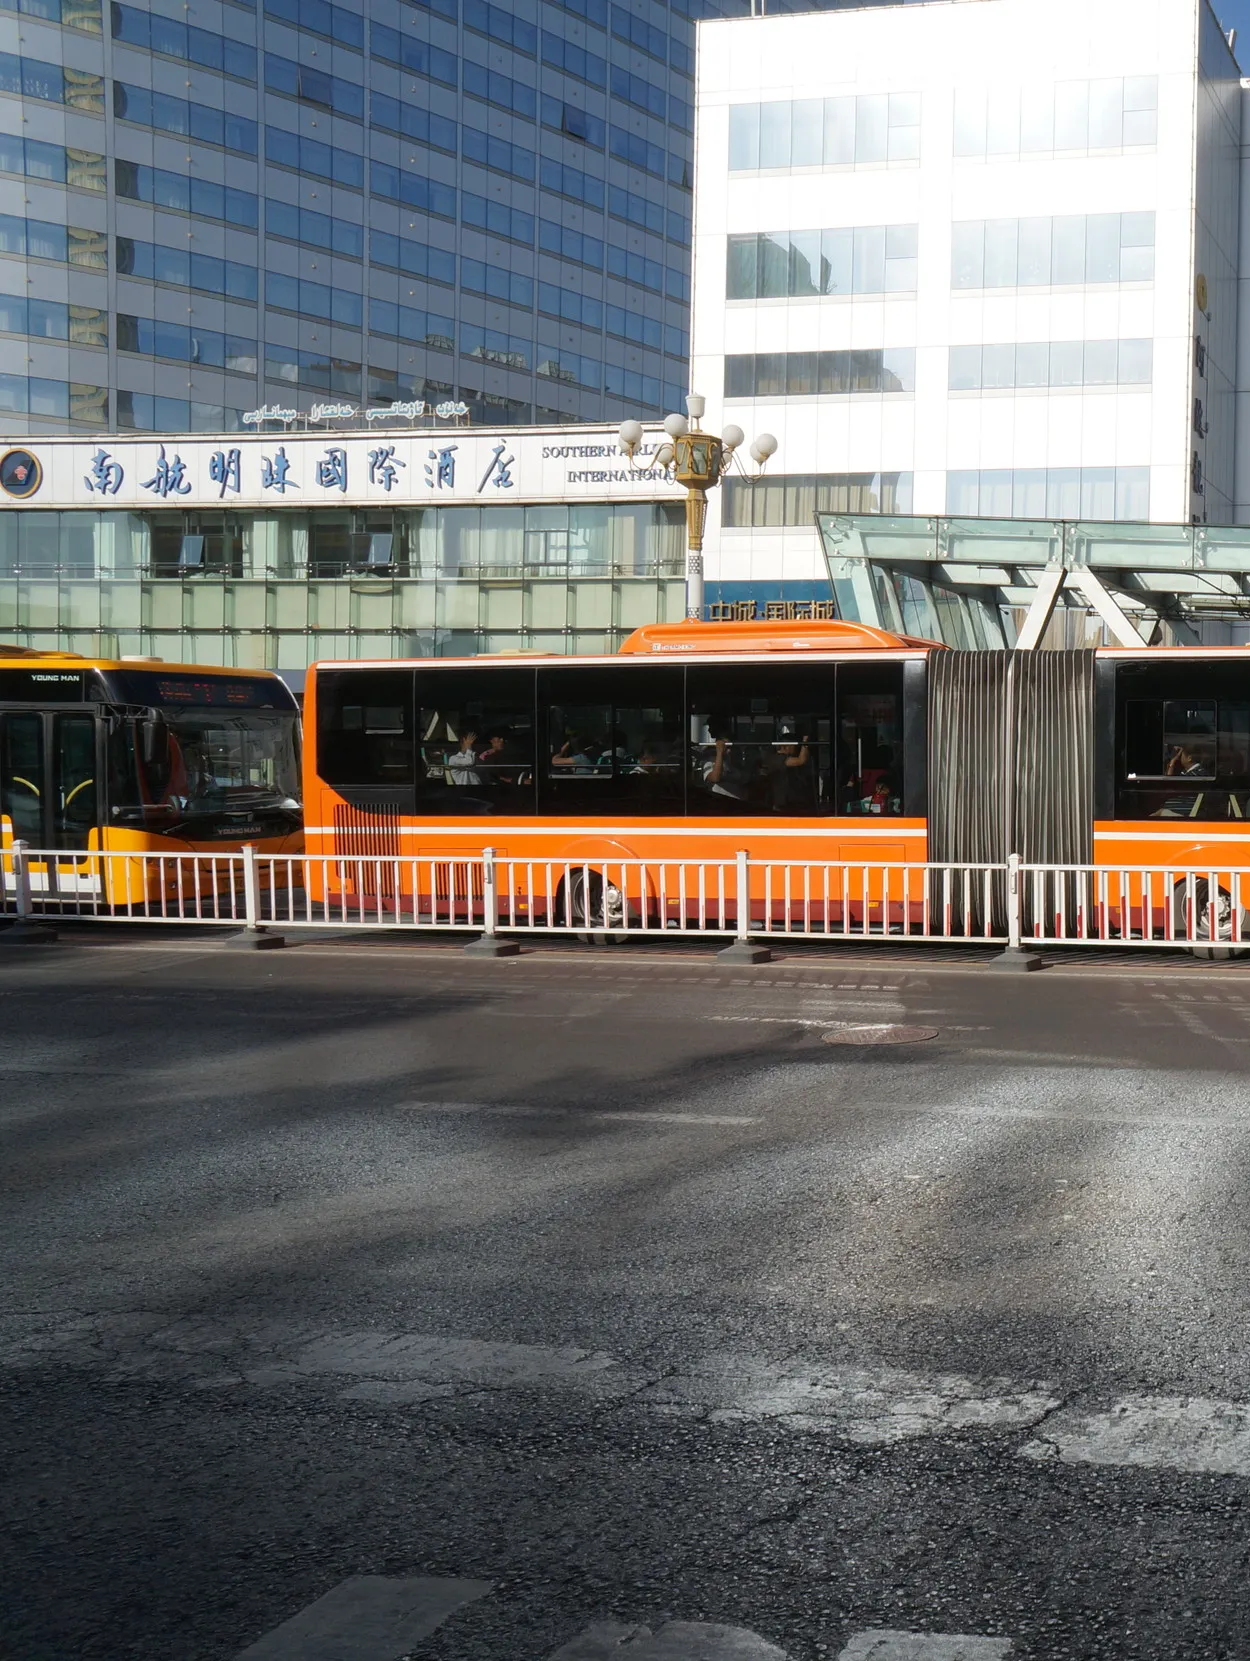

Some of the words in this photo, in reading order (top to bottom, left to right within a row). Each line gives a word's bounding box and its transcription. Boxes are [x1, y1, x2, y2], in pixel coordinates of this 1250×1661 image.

[542, 444, 616, 459] SOUTHERN
[568, 469, 672, 482] INTERNATIONA
[31, 674, 59, 682] YOUNG
[60, 674, 80, 682] MAN
